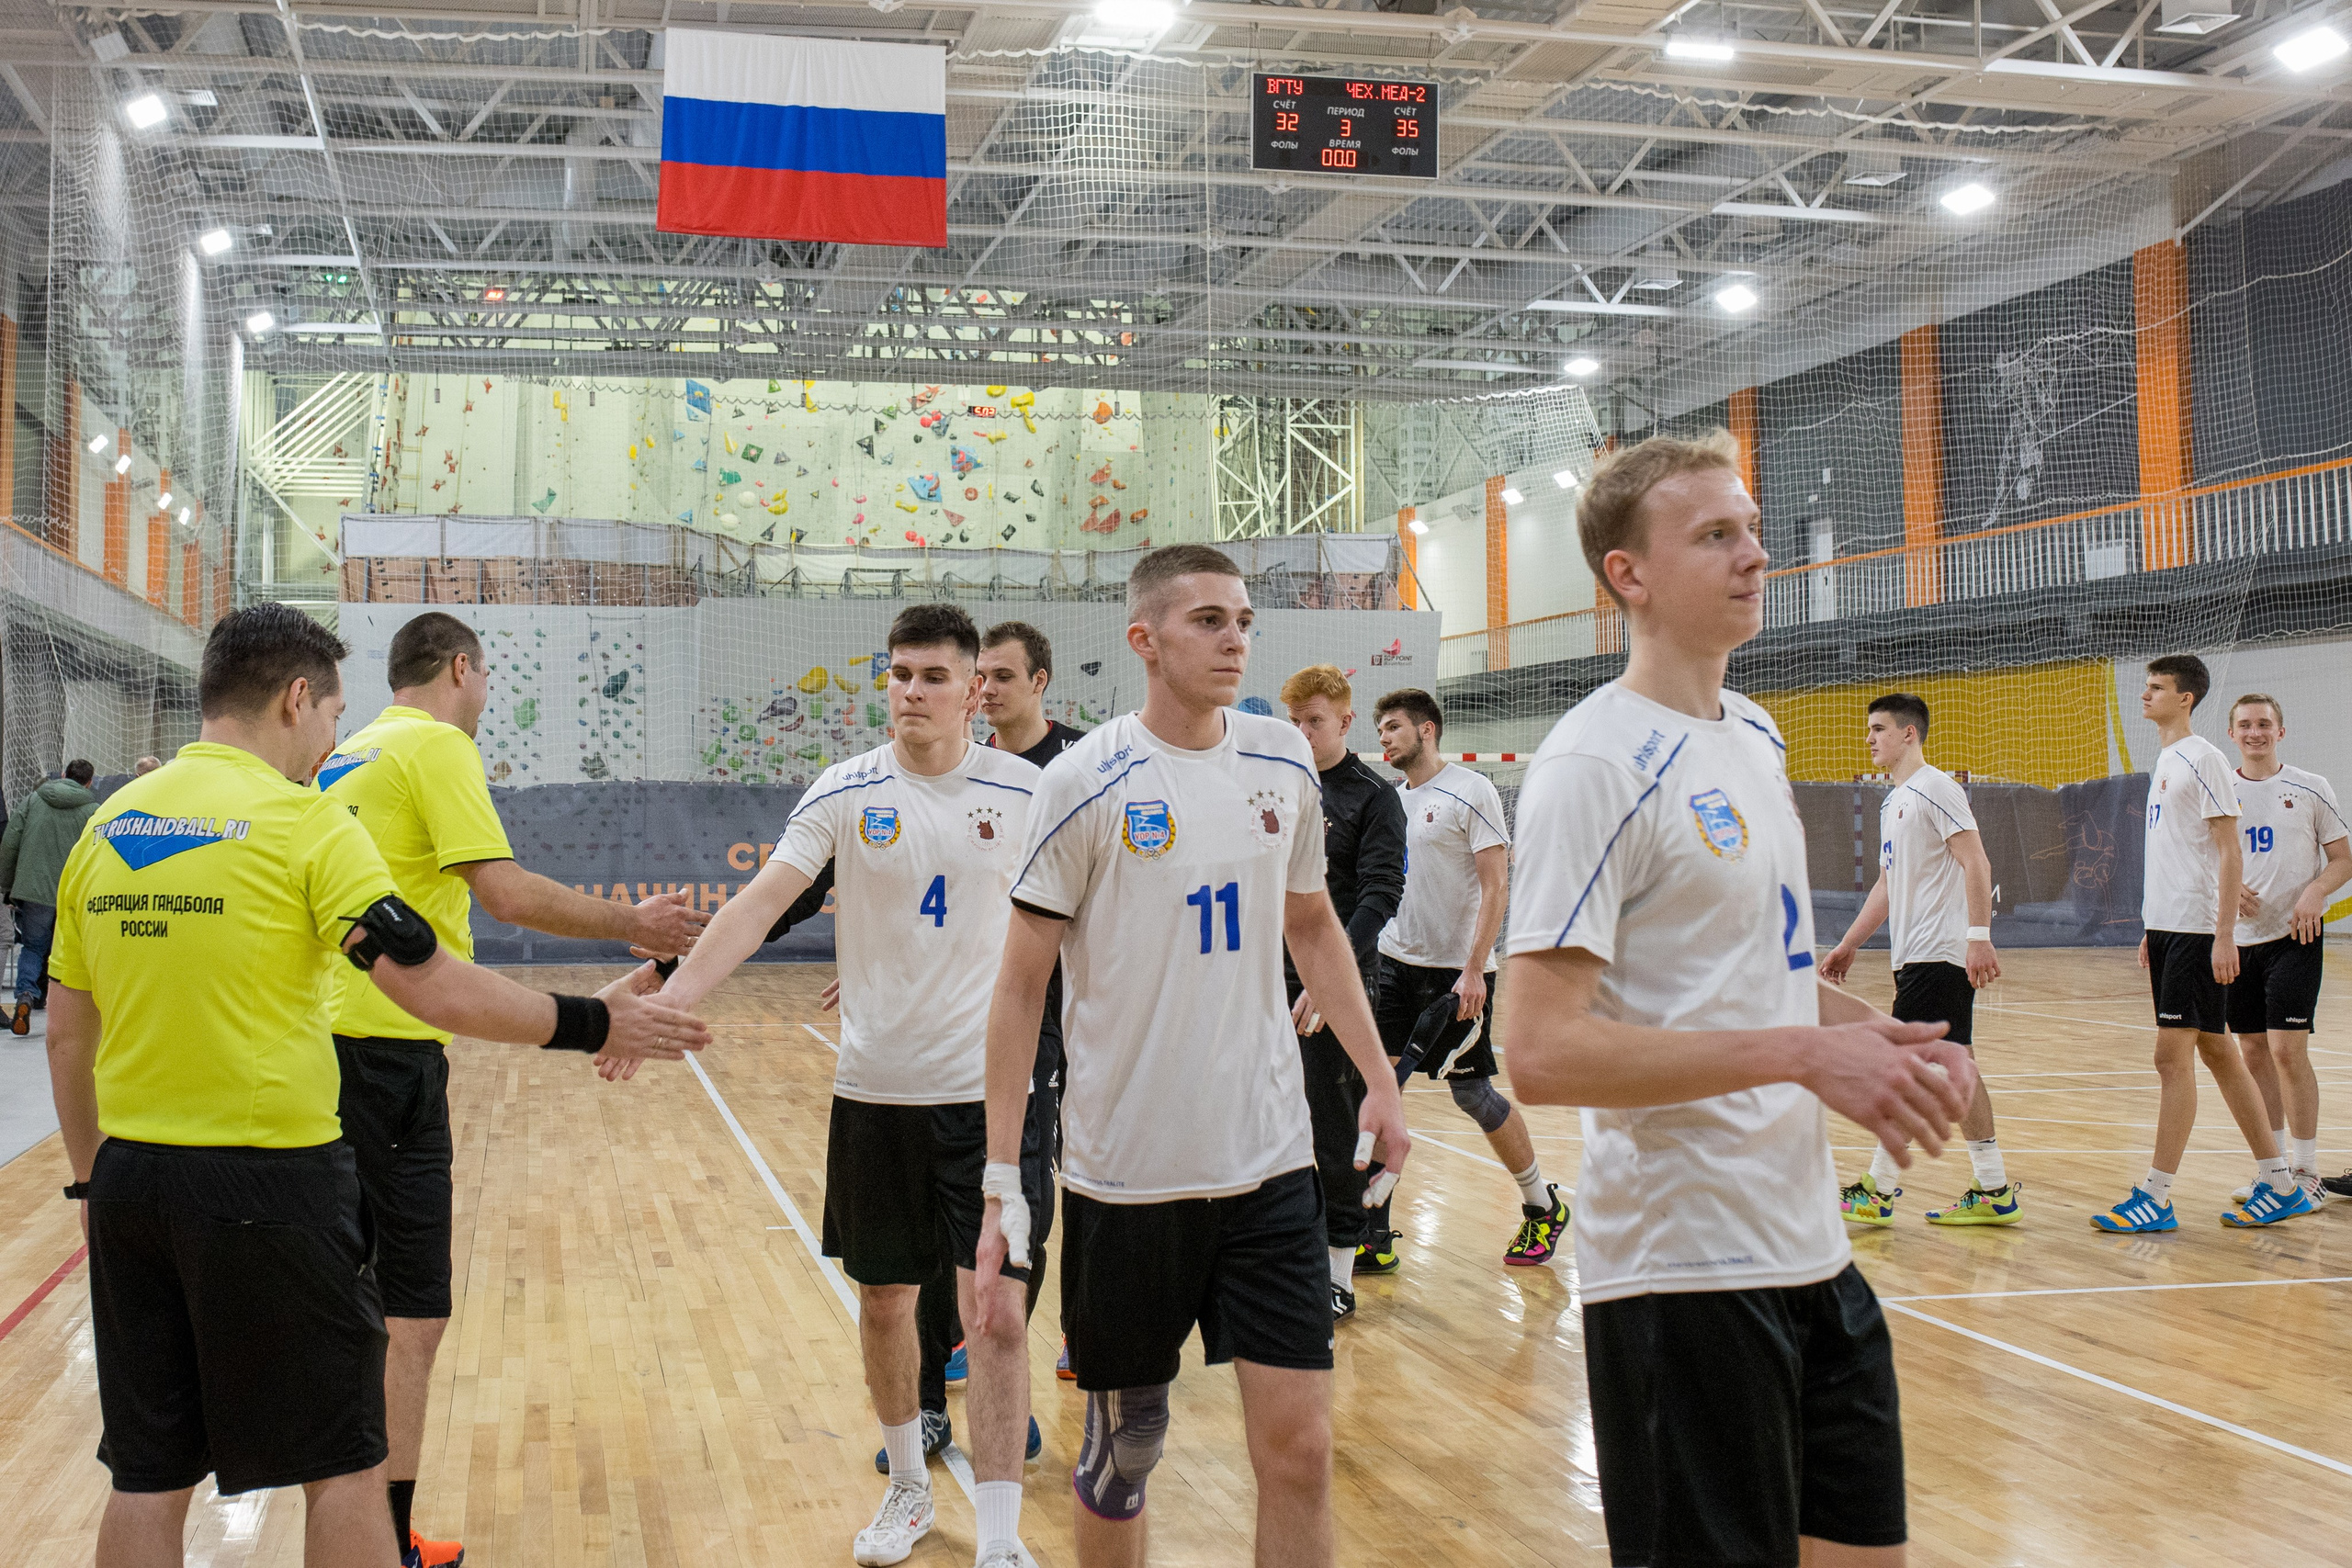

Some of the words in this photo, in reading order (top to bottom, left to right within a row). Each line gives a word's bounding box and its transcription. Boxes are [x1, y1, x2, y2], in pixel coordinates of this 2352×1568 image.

[1267, 78, 1304, 96] ВГТУ
[1346, 82, 1426, 102] ЧЕХ.МЕД-2
[1272, 99, 1296, 110] СЧЁТ
[1327, 107, 1365, 118] ПЕРИОД
[1394, 106, 1417, 117] СЧЁТ
[1276, 112, 1299, 131] 32
[1340, 118, 1351, 137] 3
[1396, 118, 1419, 138] 35
[1271, 141, 1298, 150] ФОЛЫ
[1329, 140, 1362, 149] ВРЕМЯ
[1391, 147, 1419, 156] ФОЛЫ
[2245, 826, 2274, 852] 19
[87, 895, 149, 916] ФЕДЕРАЦИЯ
[153, 895, 224, 915] ГАНДБОЛА
[920, 874, 947, 928] 4
[1186, 882, 1240, 954] 11
[121, 920, 168, 938] РОССИИ
